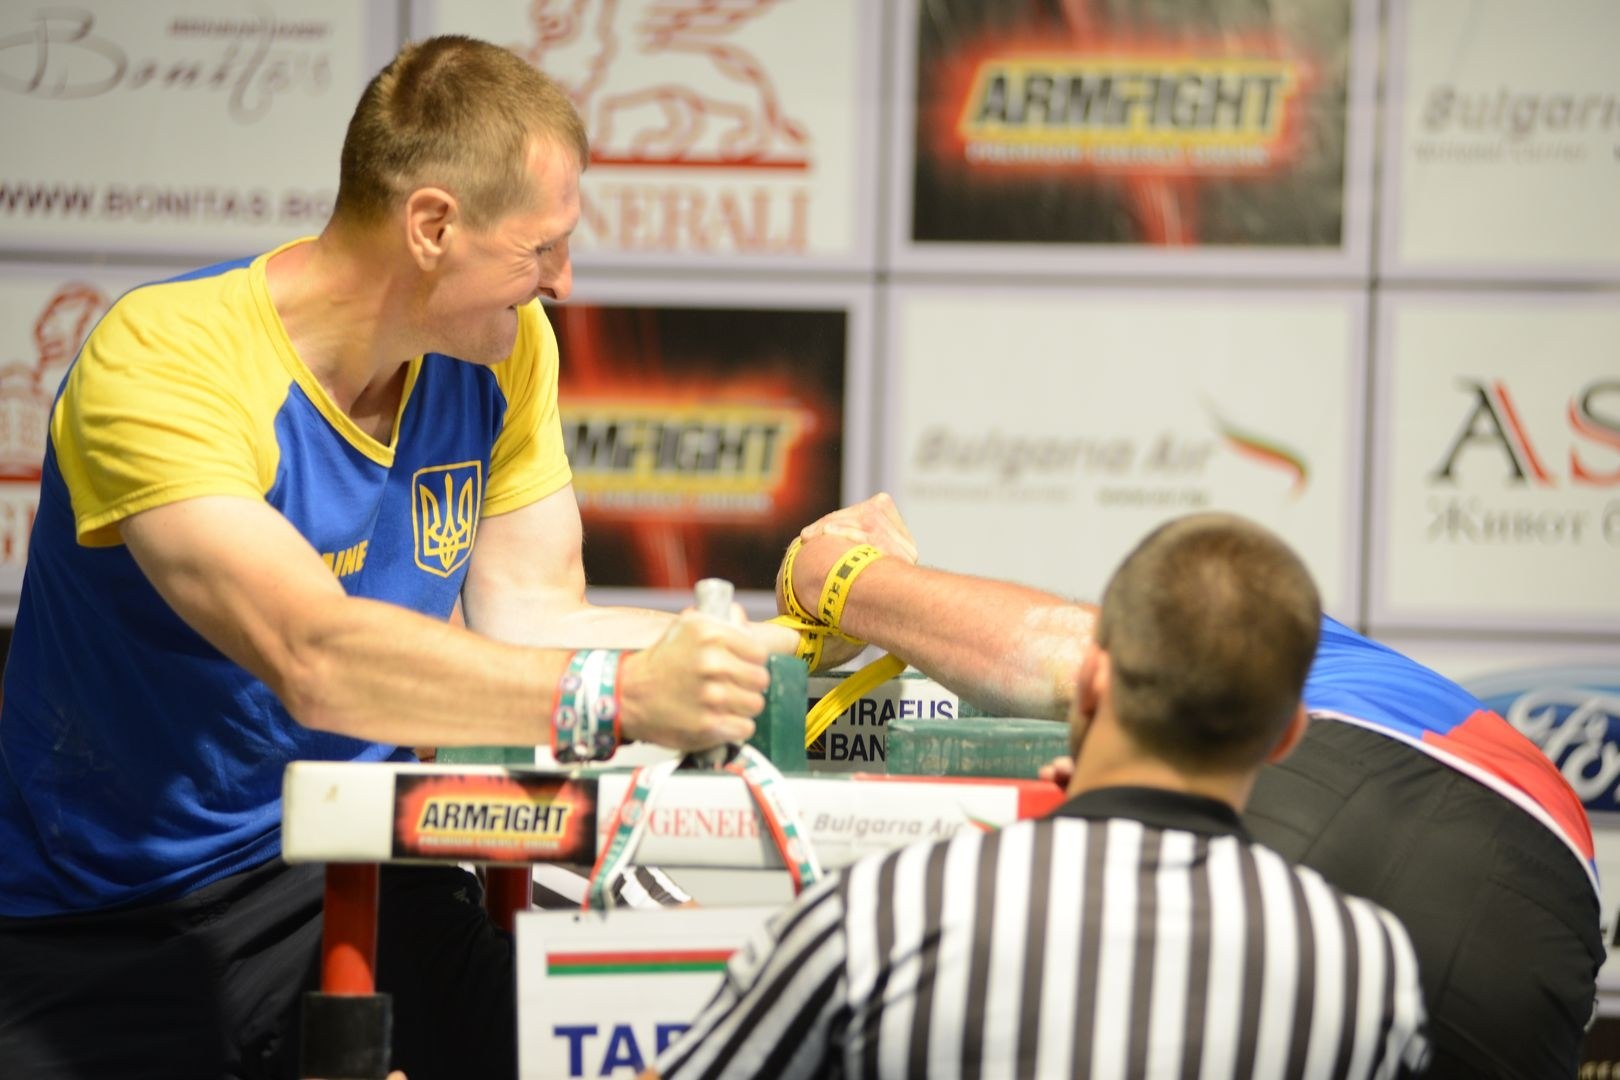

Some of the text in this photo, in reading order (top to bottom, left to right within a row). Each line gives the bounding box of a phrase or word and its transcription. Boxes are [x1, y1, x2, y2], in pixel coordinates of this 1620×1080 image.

[974, 68, 1286, 129] ARMFIGHT
[1419, 84, 1620, 143] Bulgari
[576, 187, 812, 253] NERALI
[564, 419, 782, 474] MFIGHT
[322, 540, 369, 577] INE
[831, 698, 954, 726] IRAEUS
[830, 733, 886, 762] BAN
[421, 802, 568, 834] ARMFIGHT
[649, 807, 760, 839] GENER
[812, 812, 923, 839] Bulgaria
